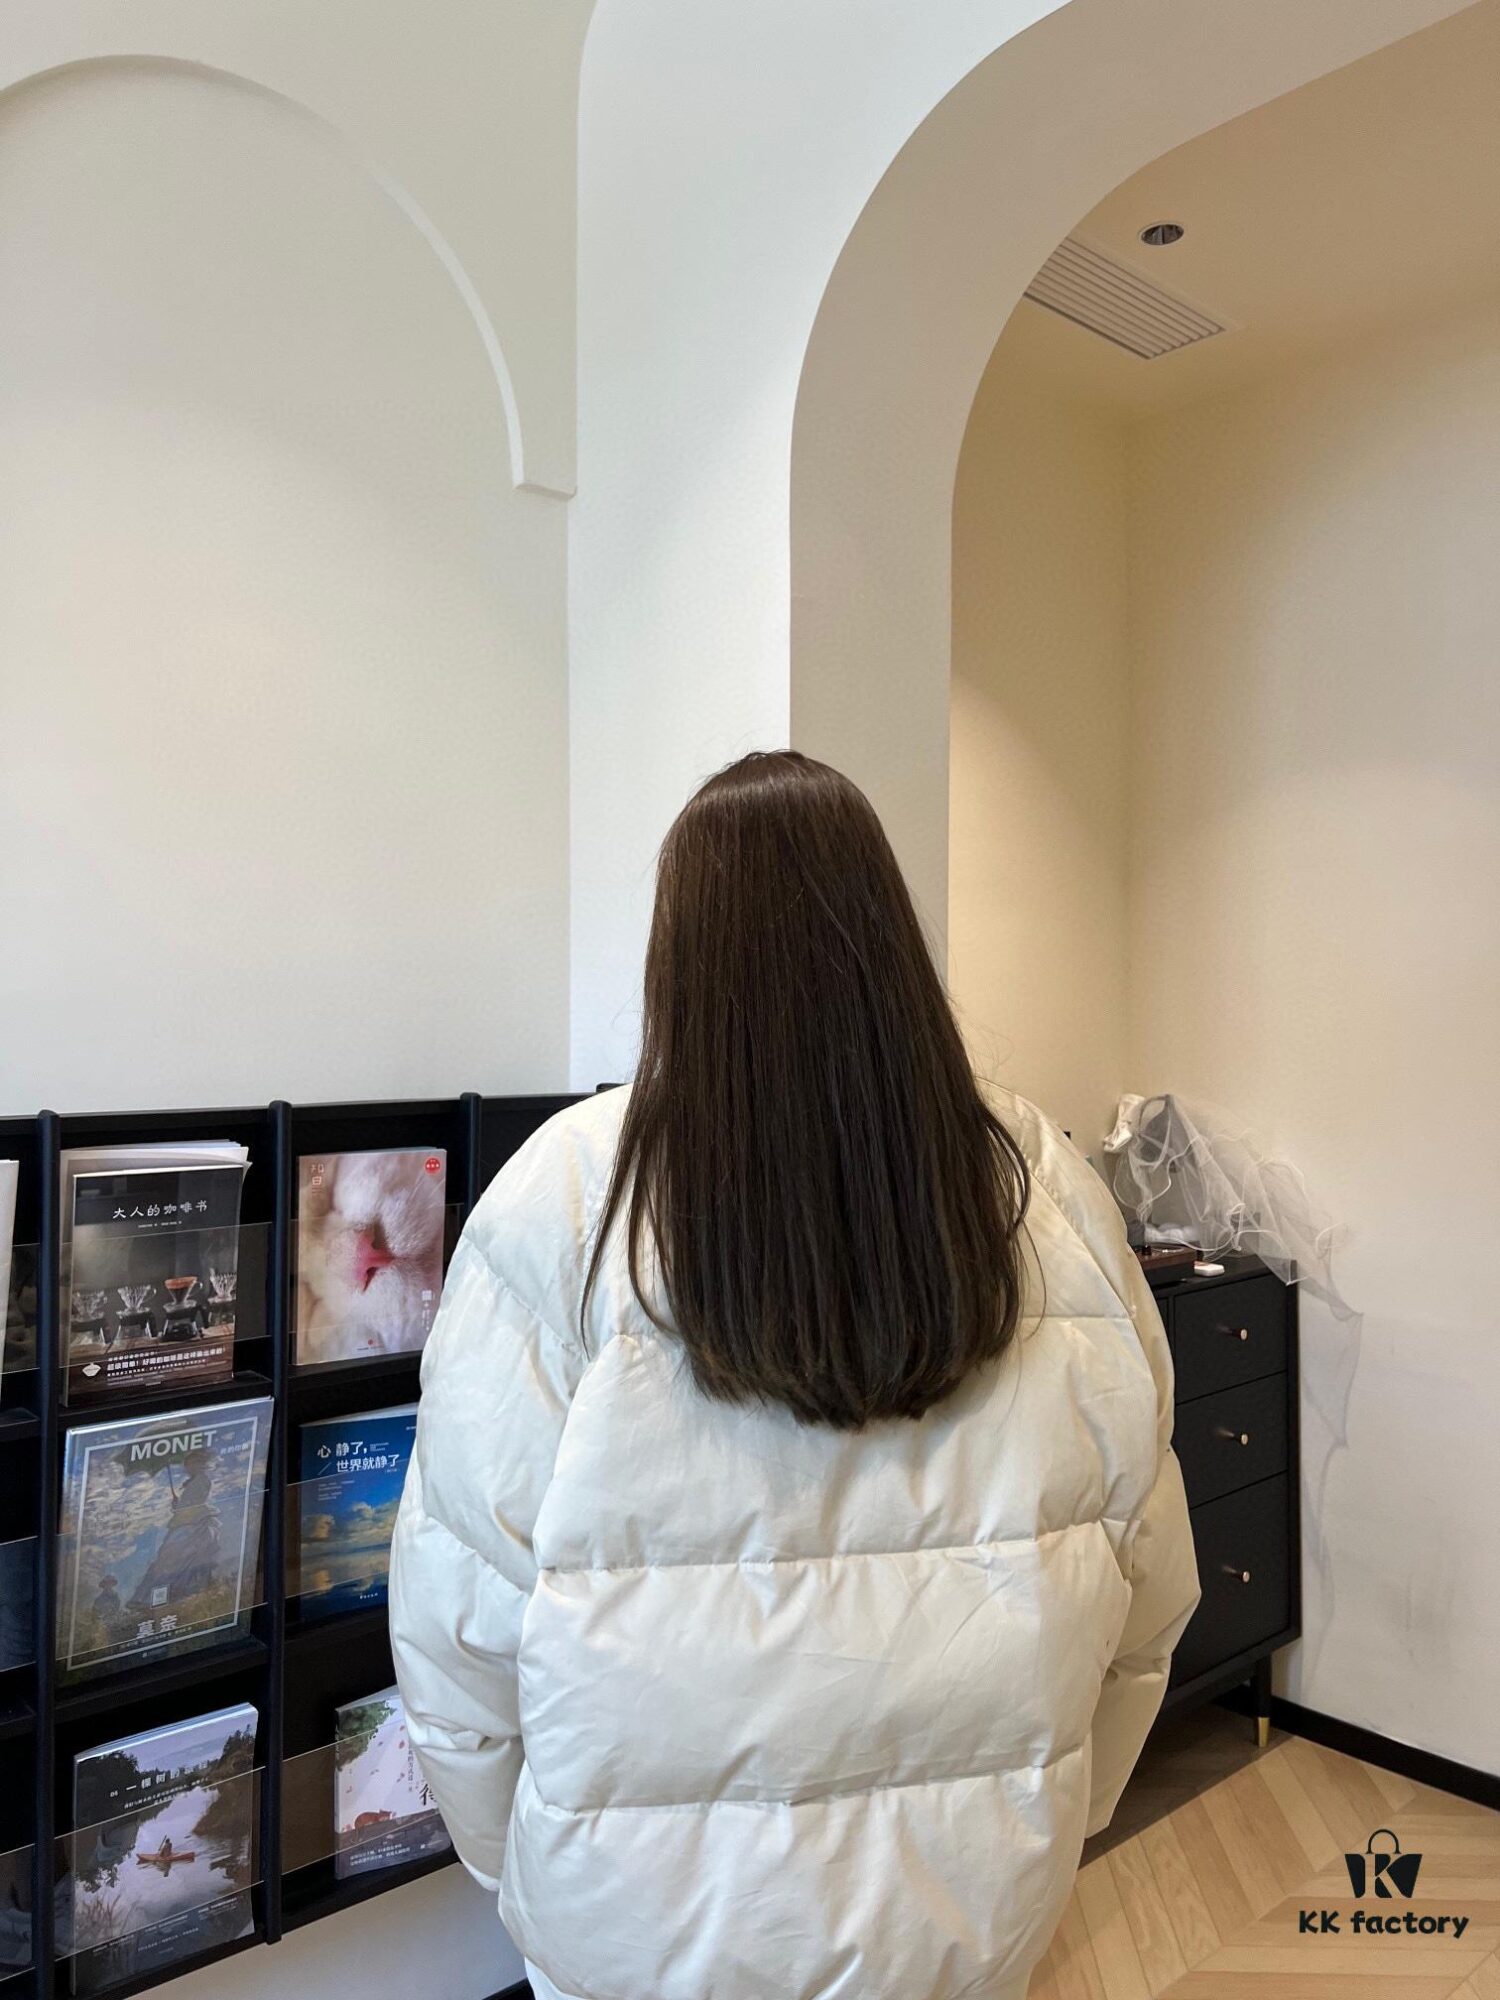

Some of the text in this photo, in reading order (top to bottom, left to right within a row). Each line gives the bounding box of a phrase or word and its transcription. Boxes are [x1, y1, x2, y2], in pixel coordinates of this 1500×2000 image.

[112, 1199, 208, 1219] 大人的咖啡书
[130, 1430, 217, 1462] MONET
[336, 1454, 400, 1473] 世界就静了
